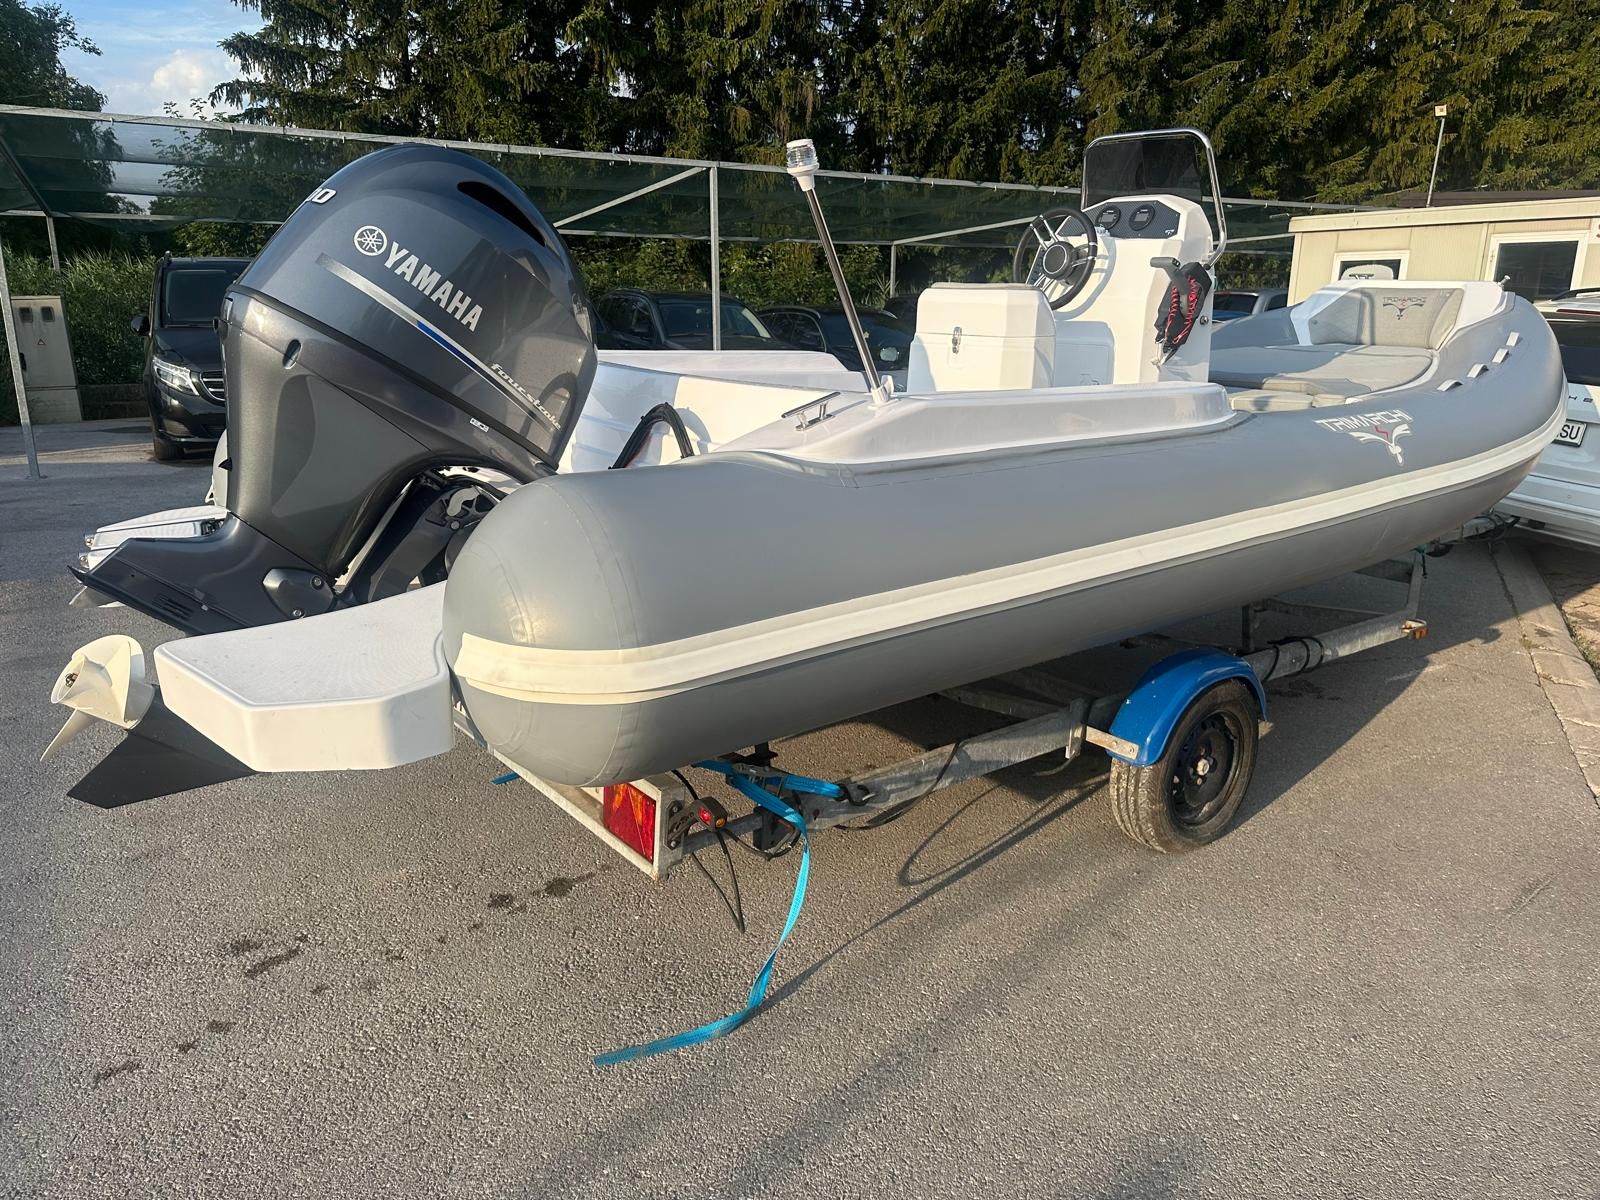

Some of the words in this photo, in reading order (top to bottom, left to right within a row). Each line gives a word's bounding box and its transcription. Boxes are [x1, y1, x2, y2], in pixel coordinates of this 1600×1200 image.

[384, 241, 483, 332] YAMAHA
[1313, 409, 1413, 432] TRIMARCHI
[1557, 424, 1580, 440] SU
